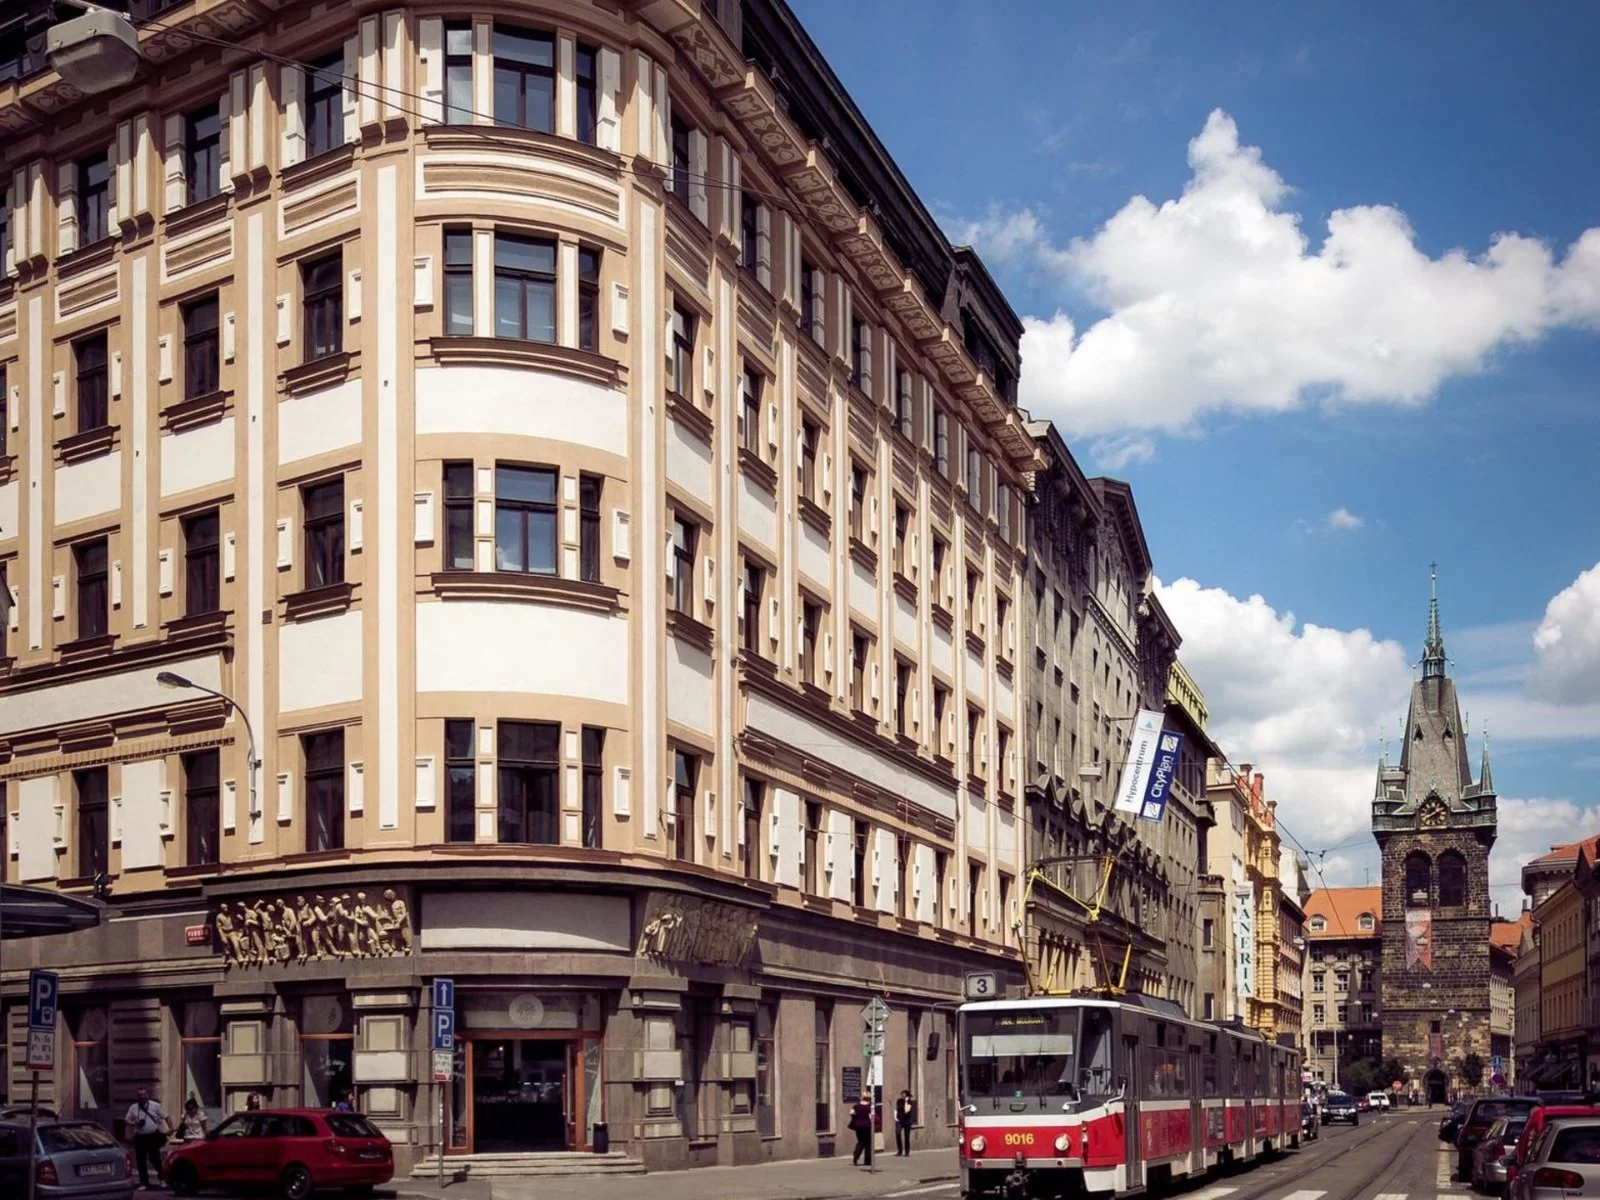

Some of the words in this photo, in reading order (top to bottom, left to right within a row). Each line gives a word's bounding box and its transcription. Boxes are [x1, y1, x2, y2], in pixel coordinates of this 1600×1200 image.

[1125, 740, 1148, 803] Hypocentrum
[1151, 755, 1172, 798] CityPlan
[35, 978, 52, 1011] P
[977, 978, 988, 994] 3
[437, 1014, 450, 1038] P
[1004, 1132, 1035, 1146] 9016
